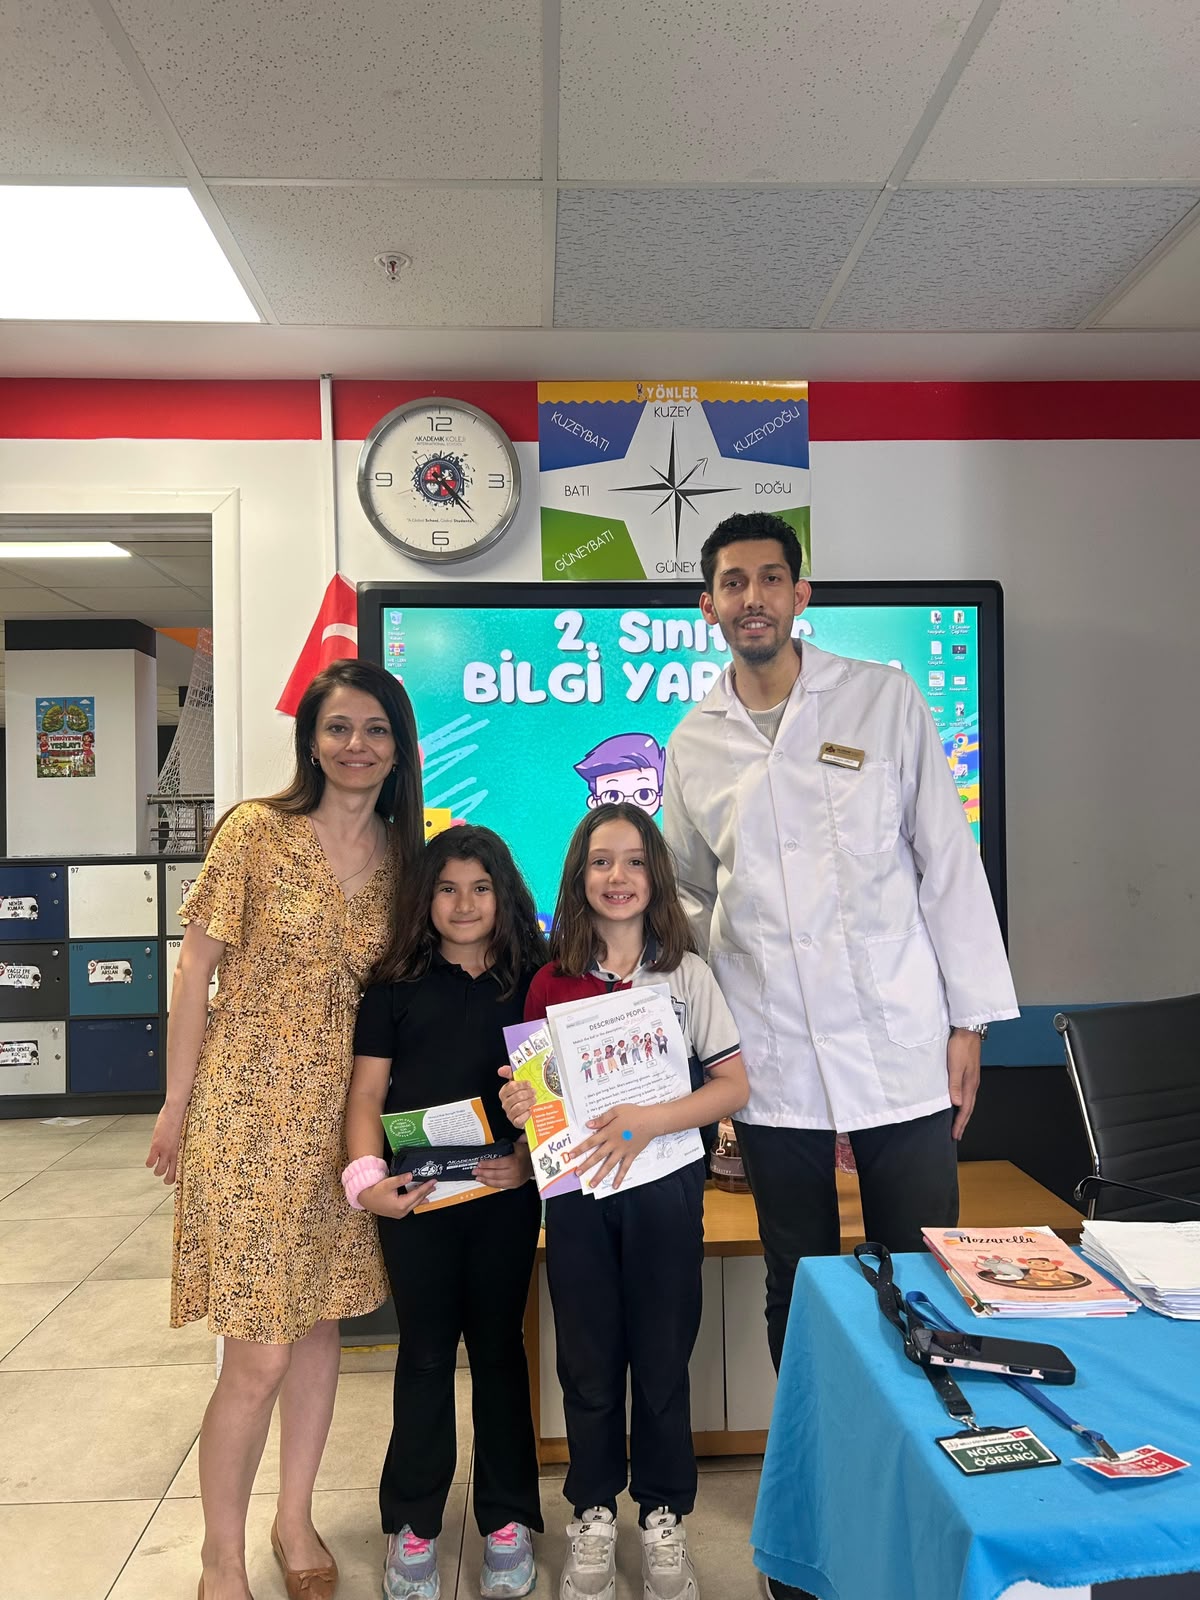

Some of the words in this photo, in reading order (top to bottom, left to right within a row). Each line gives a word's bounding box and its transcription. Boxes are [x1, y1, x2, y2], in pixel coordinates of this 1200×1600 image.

[647, 386, 699, 399] YÖNLER
[654, 405, 692, 418] KUZEY
[426, 416, 453, 432] 12
[550, 411, 610, 452] KUZEYBATI
[733, 406, 801, 453] KUZEYDOĞU
[375, 472, 393, 487] 9
[488, 473, 504, 488] 3
[564, 485, 590, 497] BATI
[754, 481, 792, 495] DOĞU
[432, 531, 449, 546] 6
[554, 529, 615, 572] GÜNEYBATI
[655, 560, 697, 574] GÜNEY
[554, 610, 598, 651] 2.
[463, 649, 602, 704] BİLGİ
[70, 866, 80, 874] 97
[166, 864, 177, 872] 96
[168, 941, 181, 949] 109
[589, 1014, 625, 1030] DESCRIBING
[626, 1007, 646, 1018] PEOPLE
[548, 1133, 572, 1156] Kari
[959, 1235, 1038, 1245] Mozzarella
[966, 1440, 1028, 1458] NÖBETÇİ
[974, 1450, 1039, 1467] ÖĞRENCİ
